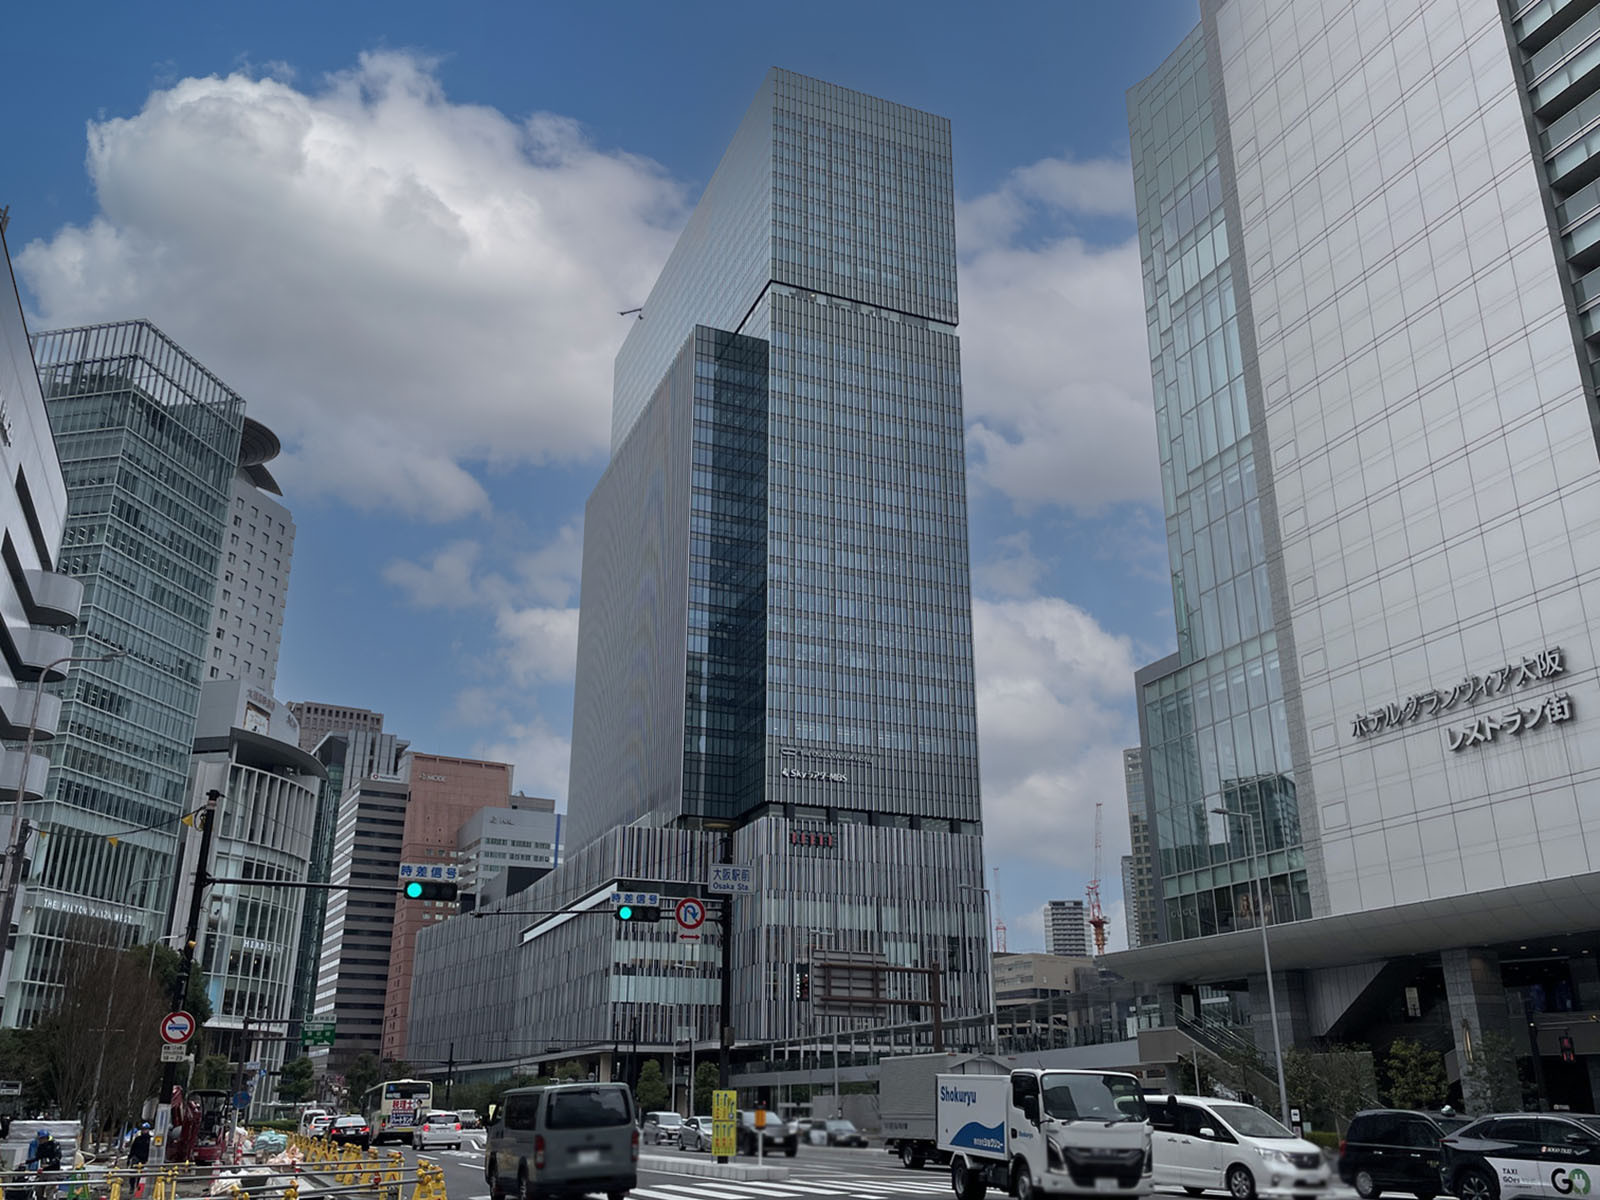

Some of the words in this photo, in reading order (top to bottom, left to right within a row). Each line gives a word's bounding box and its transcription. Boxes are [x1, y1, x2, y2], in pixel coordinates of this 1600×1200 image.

[1351, 646, 1565, 737] ホテルグランヴィア大阪
[1445, 693, 1571, 752] レストラン街
[401, 865, 456, 879] 時差信号
[713, 868, 750, 882] 大阪駅前
[712, 882, 734, 890] Osaka
[611, 892, 658, 905] 時差信号
[940, 1085, 977, 1107] Shokuryu
[1502, 1167, 1518, 1175] TAXI
[1551, 1167, 1591, 1196] GO
